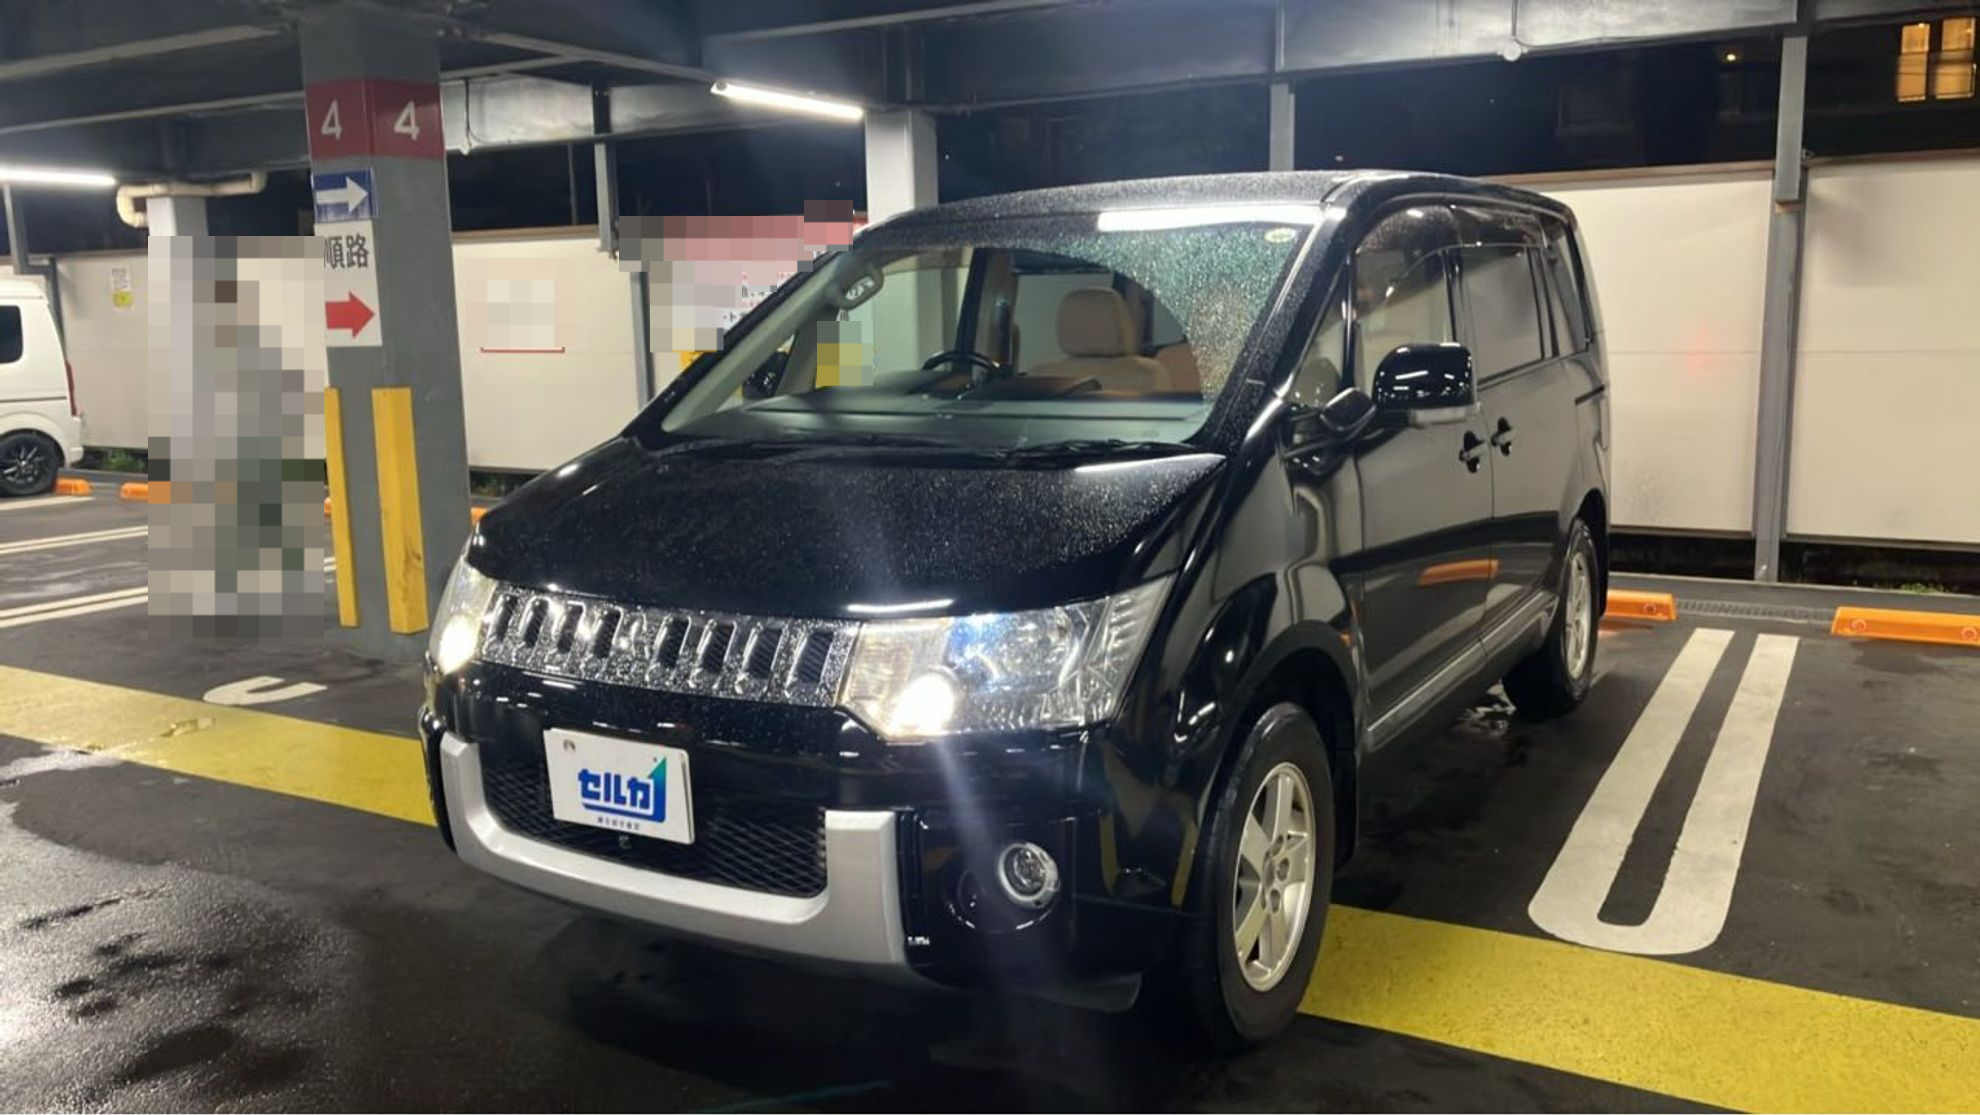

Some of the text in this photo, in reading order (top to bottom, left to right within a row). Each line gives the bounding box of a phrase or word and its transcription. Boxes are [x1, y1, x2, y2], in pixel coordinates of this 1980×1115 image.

[321, 100, 342, 140] 4
[394, 101, 420, 141] 4
[324, 233, 369, 269] 順路
[577, 768, 652, 811] セルカ
